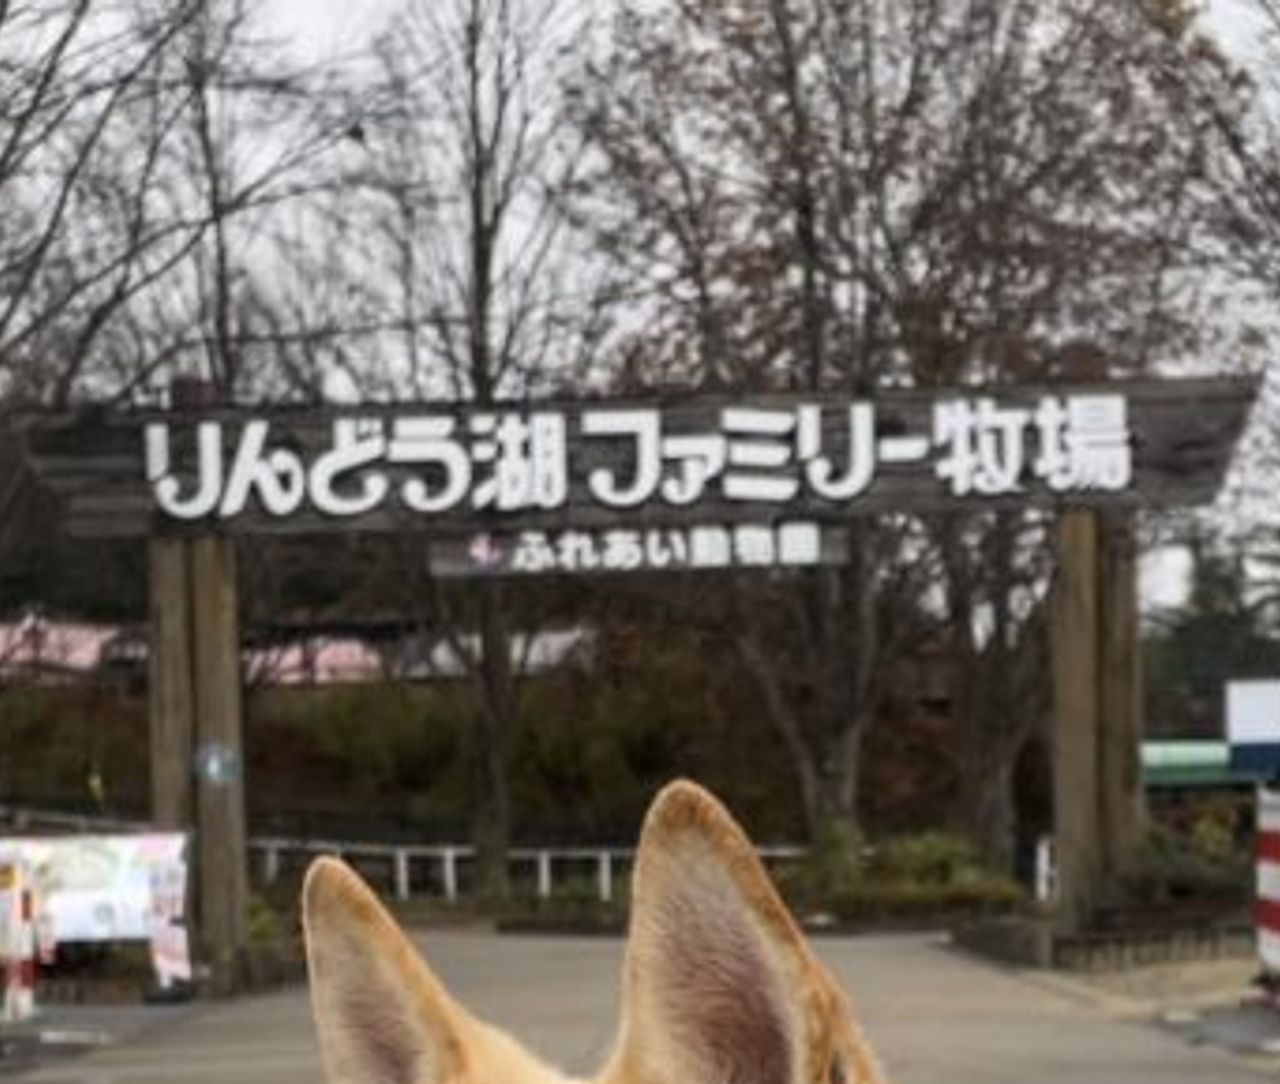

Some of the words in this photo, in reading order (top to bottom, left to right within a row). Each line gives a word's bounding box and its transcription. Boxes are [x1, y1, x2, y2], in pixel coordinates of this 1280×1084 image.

[147, 413, 568, 518] りんどう湖
[582, 396, 1132, 504] ファミリー牧場
